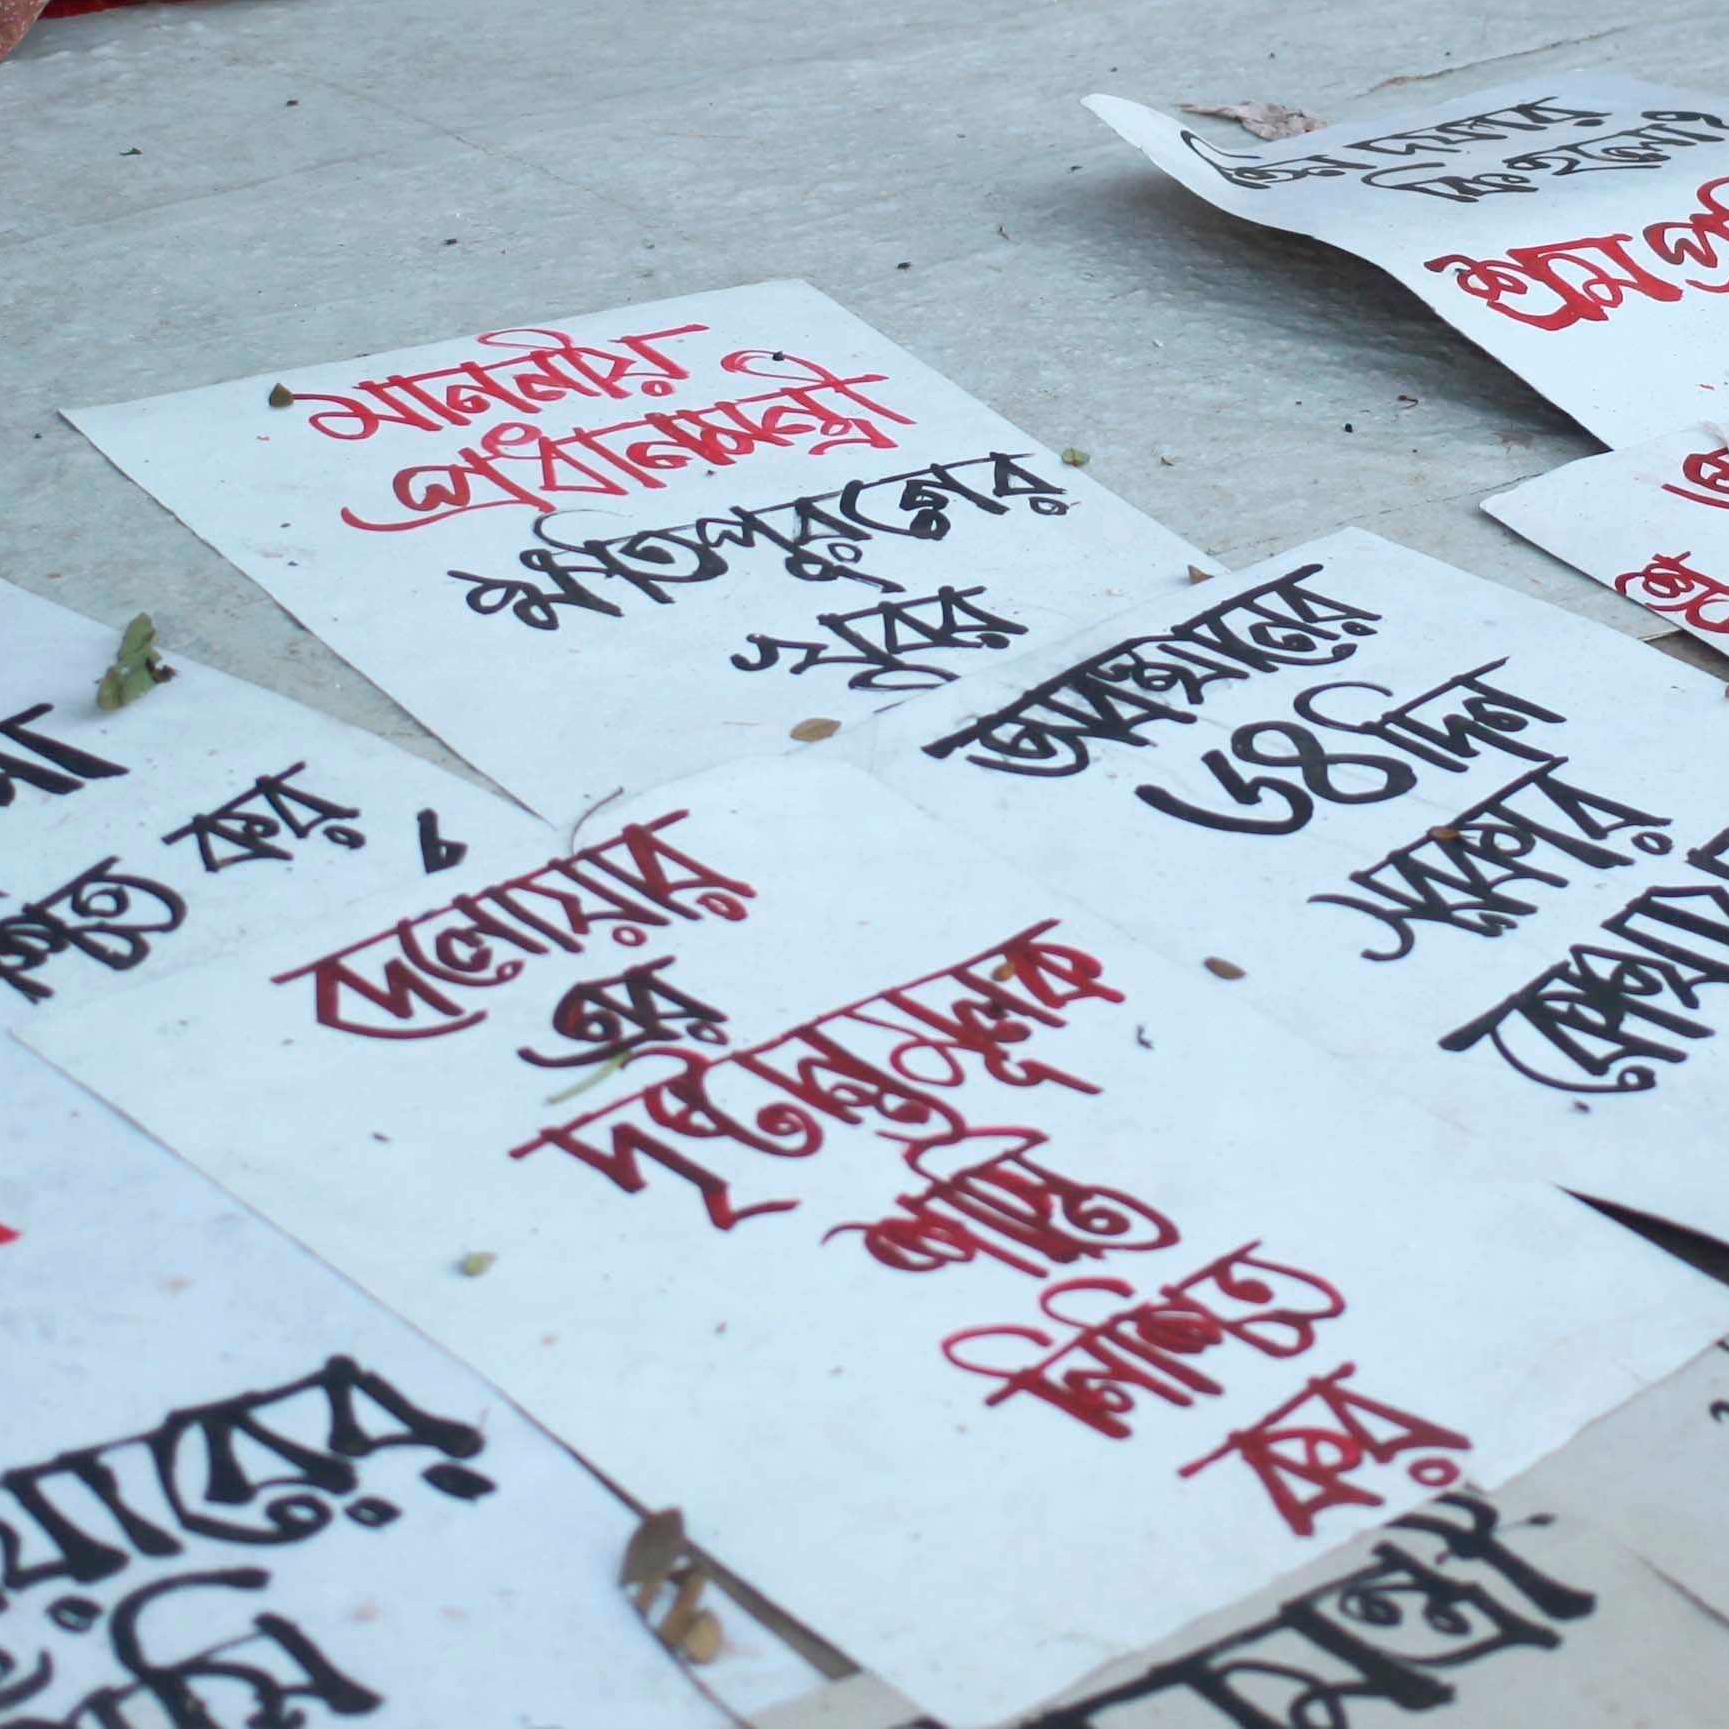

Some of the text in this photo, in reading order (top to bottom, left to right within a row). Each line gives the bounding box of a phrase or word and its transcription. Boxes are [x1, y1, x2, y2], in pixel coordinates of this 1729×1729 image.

[1424, 234, 1683, 332] শ্রম
[289, 322, 712, 442] মাননীয়
[341, 348, 917, 533] প্রধানমন্ত্রী
[161, 761, 365, 872] কর
[1136, 656, 1567, 837] ৬৪ দিন
[1307, 755, 1674, 963] সরকার
[1180, 1360, 1474, 1537] কর
